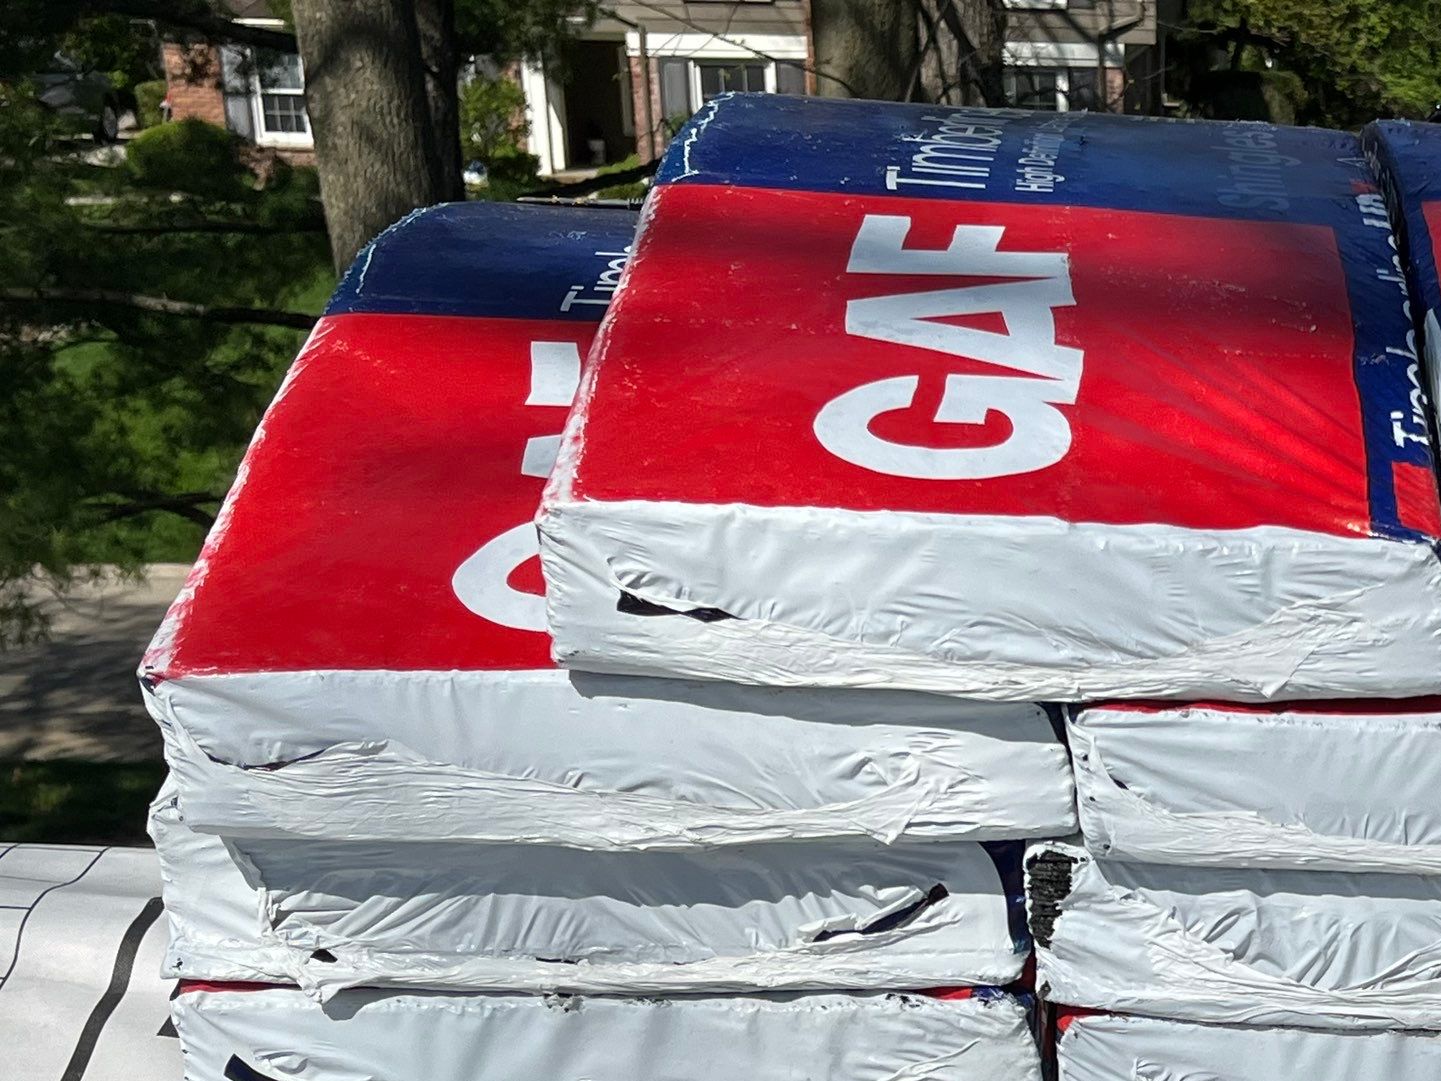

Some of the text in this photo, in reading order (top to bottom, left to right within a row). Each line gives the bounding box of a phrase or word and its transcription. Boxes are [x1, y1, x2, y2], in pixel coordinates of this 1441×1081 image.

[1014, 167, 1066, 192] High
[1211, 130, 1301, 210] Shingles
[812, 214, 1084, 481] GAF
